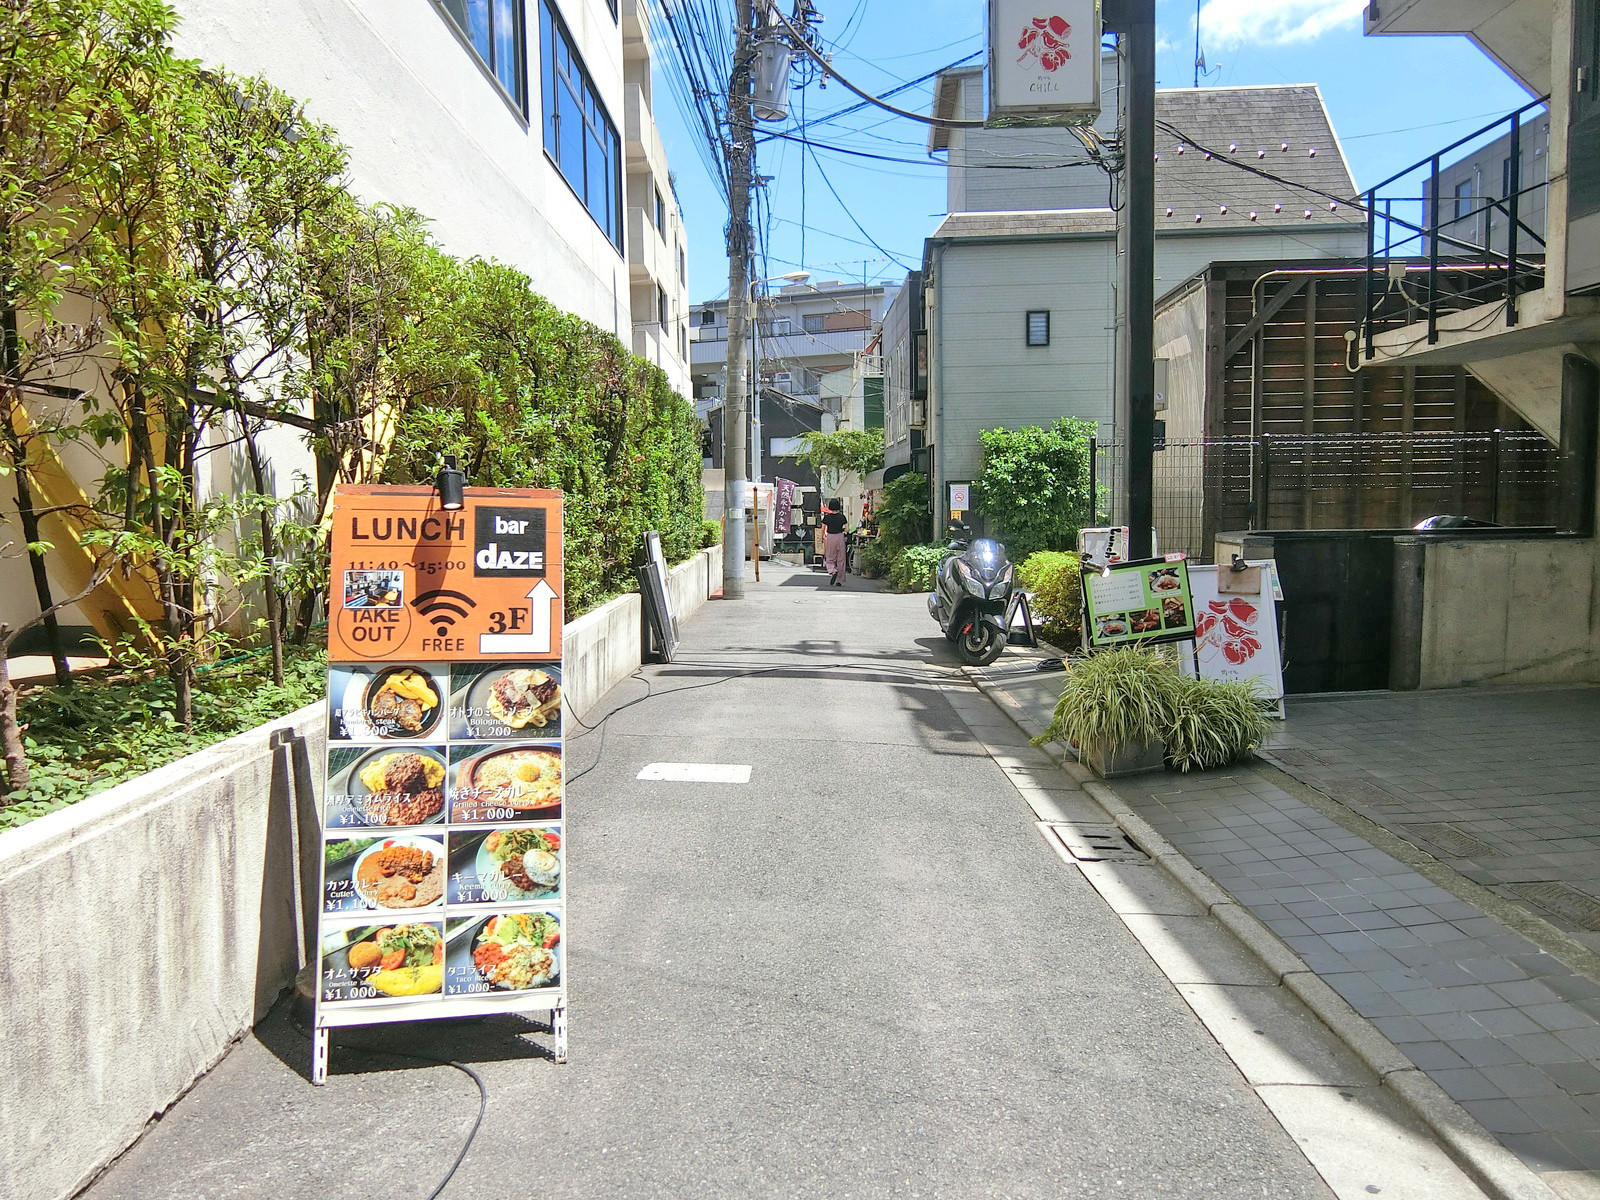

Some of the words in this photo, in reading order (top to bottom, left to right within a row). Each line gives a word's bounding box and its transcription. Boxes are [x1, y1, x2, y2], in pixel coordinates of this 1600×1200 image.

[352, 517, 465, 541] LUNCH
[495, 516, 529, 535] bar
[351, 609, 400, 623] TAKE
[489, 607, 529, 634] 3F
[352, 626, 395, 642] OUT
[422, 639, 465, 652] FREE
[450, 706, 534, 718] オトナのミートソース
[449, 786, 537, 801] 焼きチーズカレー
[452, 870, 523, 884] キーマカレー
[326, 879, 383, 892] カツカレー
[324, 965, 384, 980] オムサラダ
[447, 964, 498, 977] タコライス
